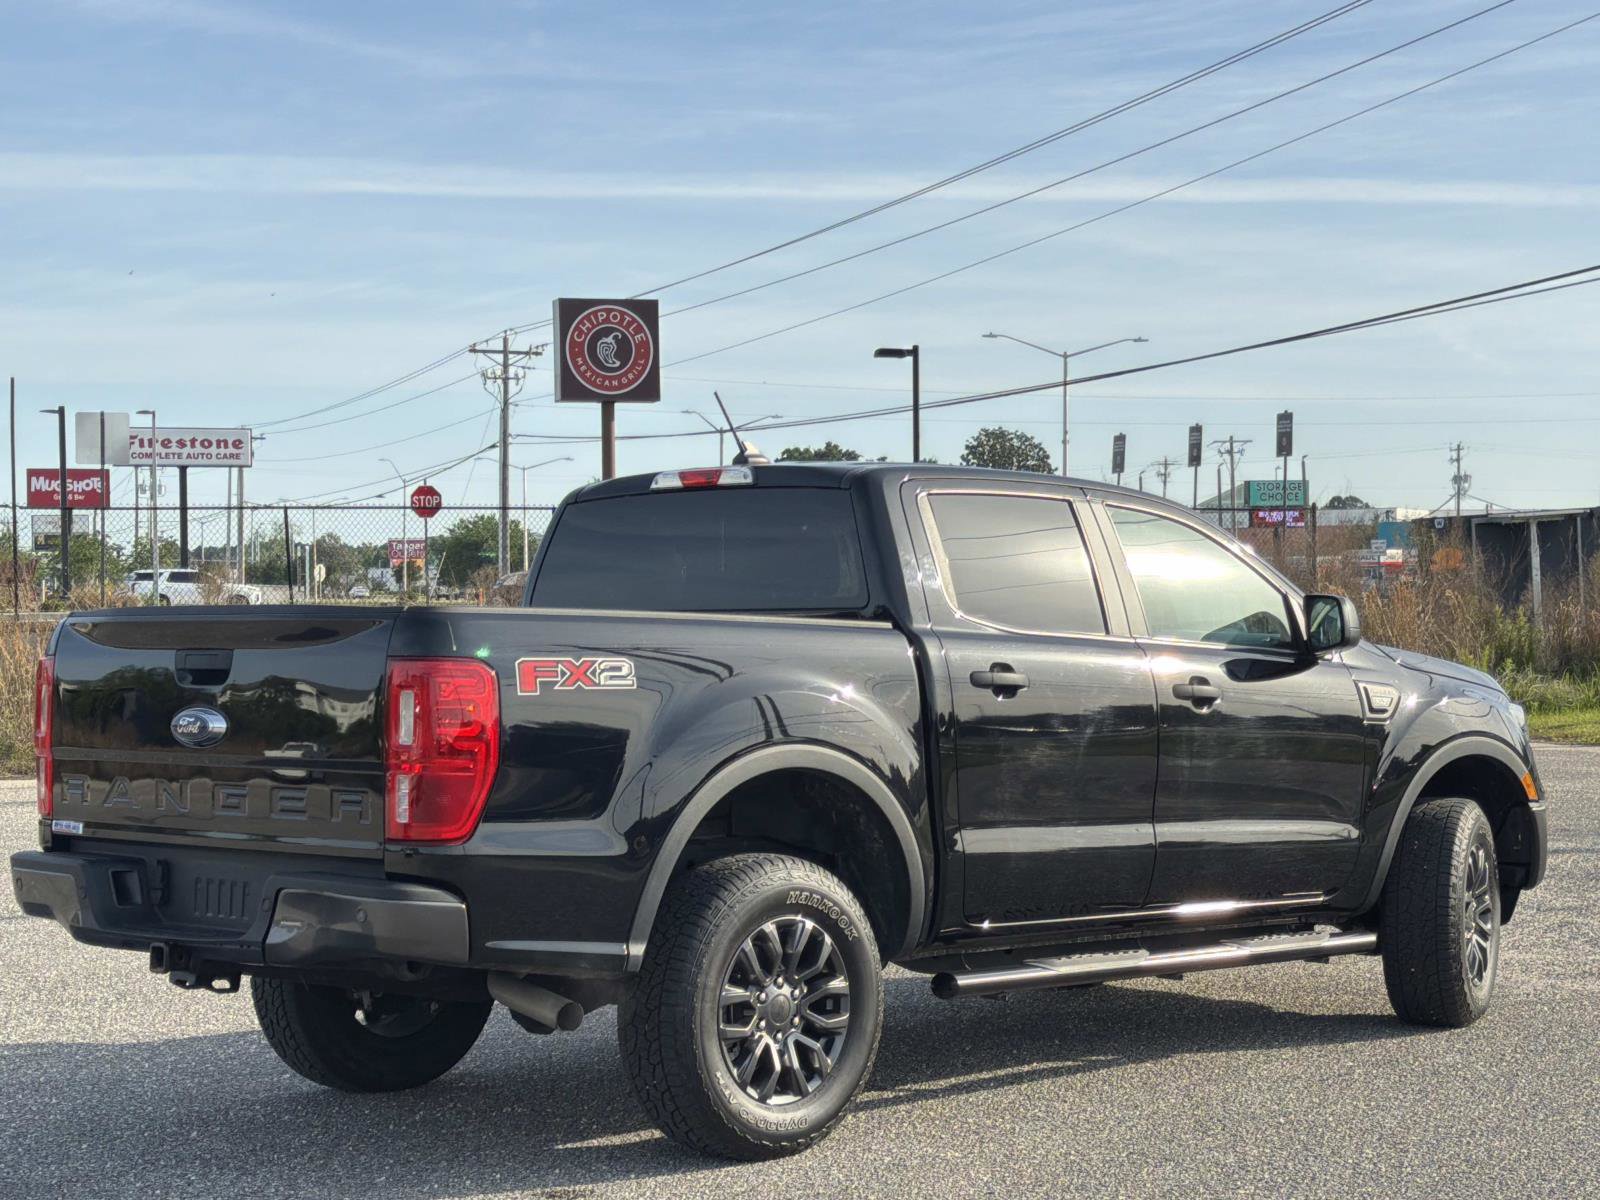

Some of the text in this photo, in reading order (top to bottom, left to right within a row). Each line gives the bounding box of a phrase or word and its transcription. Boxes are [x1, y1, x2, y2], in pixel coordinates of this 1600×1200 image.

[574, 311, 646, 344] CHIPOTLE
[576, 357, 645, 387] MEXICAN GRILL
[129, 433, 244, 450] Firestone
[186, 452, 213, 460] AUTO
[215, 452, 241, 461] CARE
[1256, 482, 1304, 492] STORAGE
[412, 495, 440, 508] STOP
[1259, 492, 1300, 502] CHOCE
[515, 657, 637, 695] FX2
[177, 717, 200, 734] Ford
[60, 772, 371, 825] RANGER
